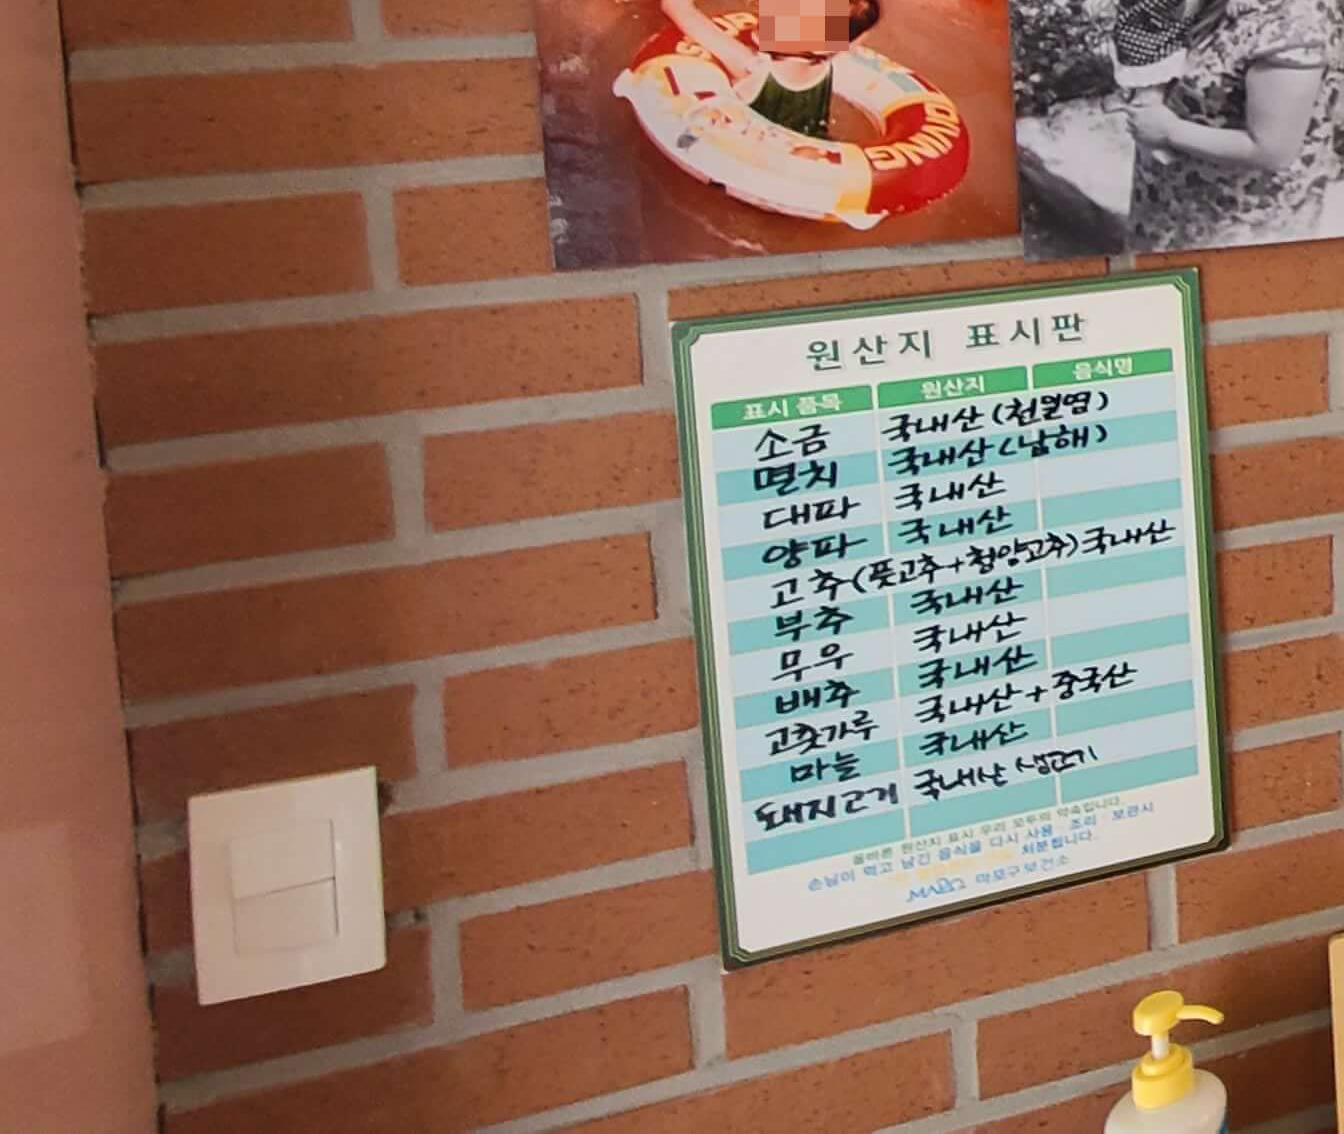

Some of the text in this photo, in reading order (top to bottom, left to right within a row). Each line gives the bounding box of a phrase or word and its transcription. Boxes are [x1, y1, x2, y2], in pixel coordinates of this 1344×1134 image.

[805, 312, 1088, 371] 원산지 표시판
[1072, 356, 1134, 380] 음식명
[741, 392, 843, 420] 표시 품목
[920, 375, 986, 401] 원산지
[754, 422, 832, 463] 소금
[754, 459, 840, 495] 멸치
[893, 470, 1008, 513] 국내산
[762, 496, 862, 530] 대파
[897, 505, 1014, 546] 국내산
[762, 532, 868, 571] 양파
[1080, 518, 1178, 557] 국내산
[909, 577, 1026, 616] 국내산
[773, 606, 856, 644] 부추
[912, 612, 1028, 653] 국내산
[772, 642, 854, 683] 무우
[918, 645, 1040, 689] 국내산
[774, 680, 861, 718] 배추
[764, 709, 880, 757] 고춧가루
[918, 719, 1031, 757] 국내산
[790, 750, 863, 784] 마늘
[912, 746, 1099, 802] 국내산 생고기
[754, 781, 899, 831] 돼지고기
[990, 833, 1021, 853] 다시
